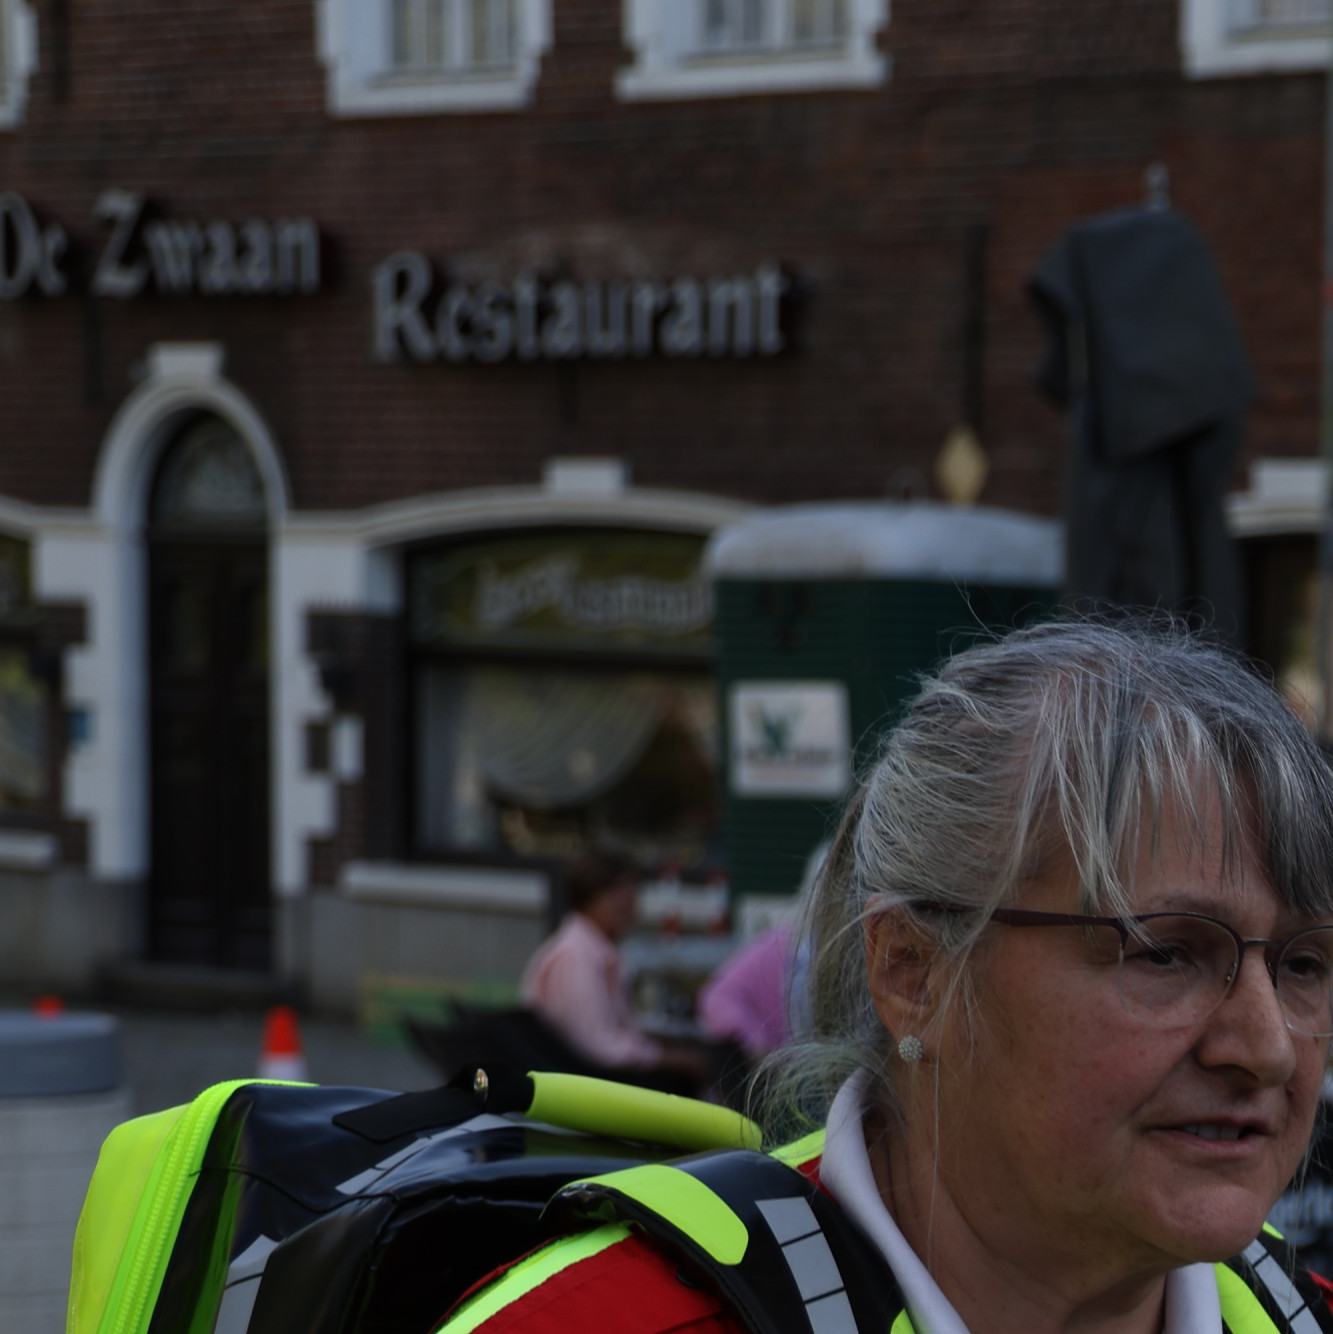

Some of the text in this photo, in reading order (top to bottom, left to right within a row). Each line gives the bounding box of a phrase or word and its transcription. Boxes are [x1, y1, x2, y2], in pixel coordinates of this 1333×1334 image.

[0, 189, 321, 299] De Zwaan
[371, 249, 789, 363] Restaurant
